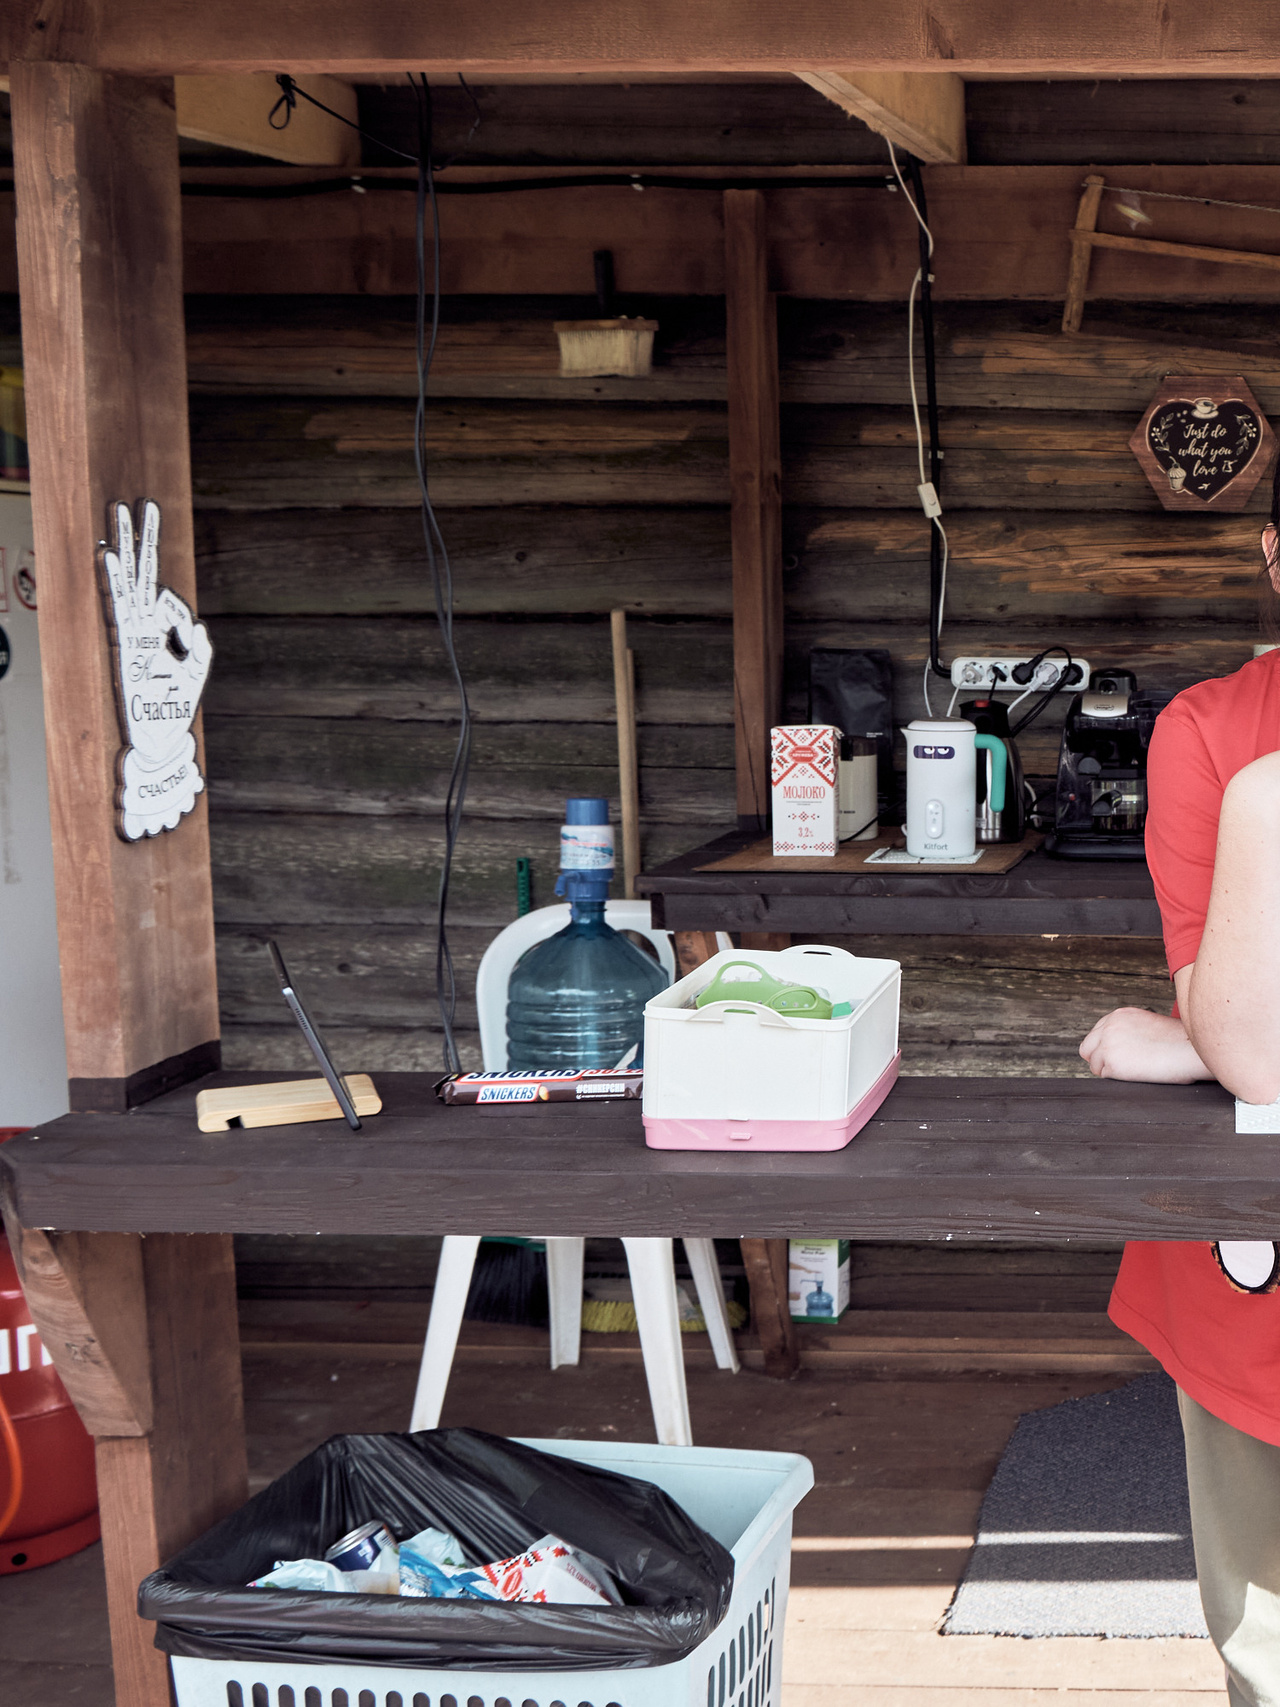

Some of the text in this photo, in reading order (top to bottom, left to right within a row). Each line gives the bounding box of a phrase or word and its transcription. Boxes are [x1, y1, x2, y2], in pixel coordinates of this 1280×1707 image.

[1183, 422, 1227, 439] Just do
[1178, 438, 1233, 463] what you
[1193, 460, 1218, 477] love
[131, 693, 192, 722] Счастья
[783, 785, 826, 799] МОЛОКО
[923, 843, 949, 851] Kitfort
[480, 1086, 536, 1101] SNICKERS
